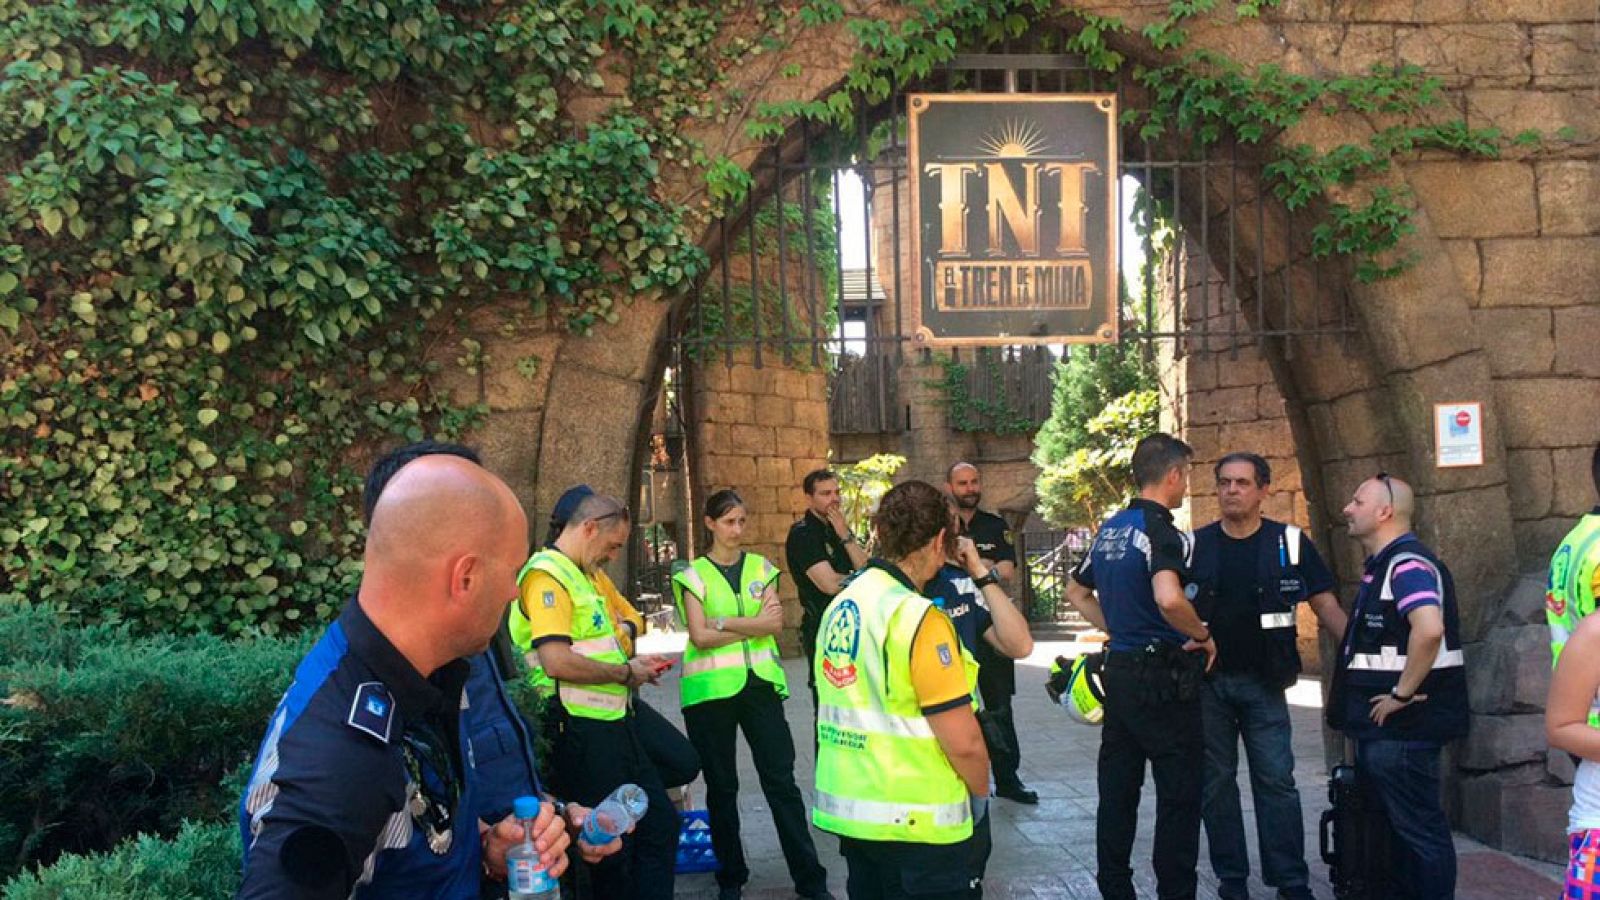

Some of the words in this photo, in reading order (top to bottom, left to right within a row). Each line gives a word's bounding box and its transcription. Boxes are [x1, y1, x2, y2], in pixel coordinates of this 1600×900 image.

[924, 162, 1102, 258] TNT
[944, 266, 956, 285] EL
[960, 265, 1012, 306] TREN
[1016, 266, 1031, 285] DE
[1034, 264, 1086, 306] MINA
